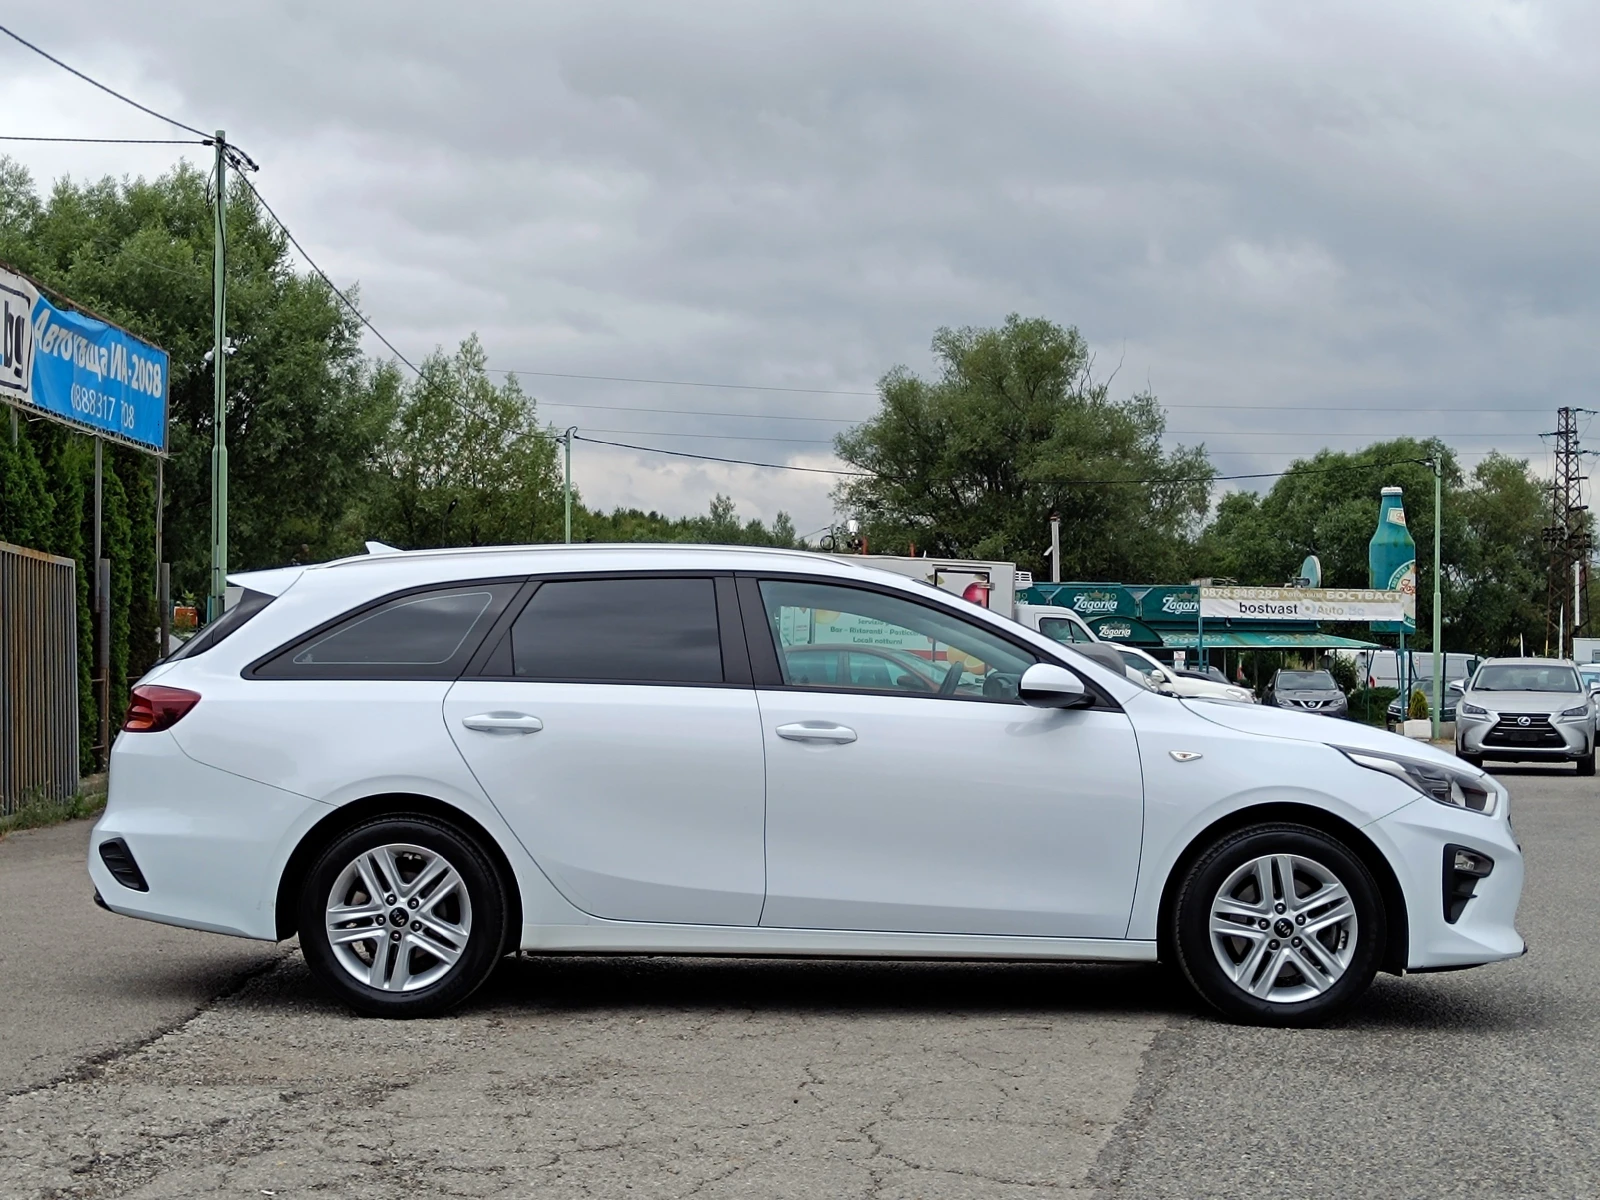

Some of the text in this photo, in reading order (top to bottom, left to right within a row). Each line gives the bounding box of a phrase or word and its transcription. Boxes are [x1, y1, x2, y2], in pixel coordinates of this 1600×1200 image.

[34, 308, 162, 398] Автокъща ИА-2008
[1201, 588, 1280, 600] 0878 848 284
[1326, 591, 1402, 601] БОСТВАСТ
[1073, 595, 1118, 613] Zagorka
[1239, 602, 1298, 614] bostvast
[849, 626, 883, 635] Ristoranti
[1099, 624, 1131, 638] Zagorka
[852, 636, 903, 645] Locali notturni
[1277, 921, 1291, 936] KIA
